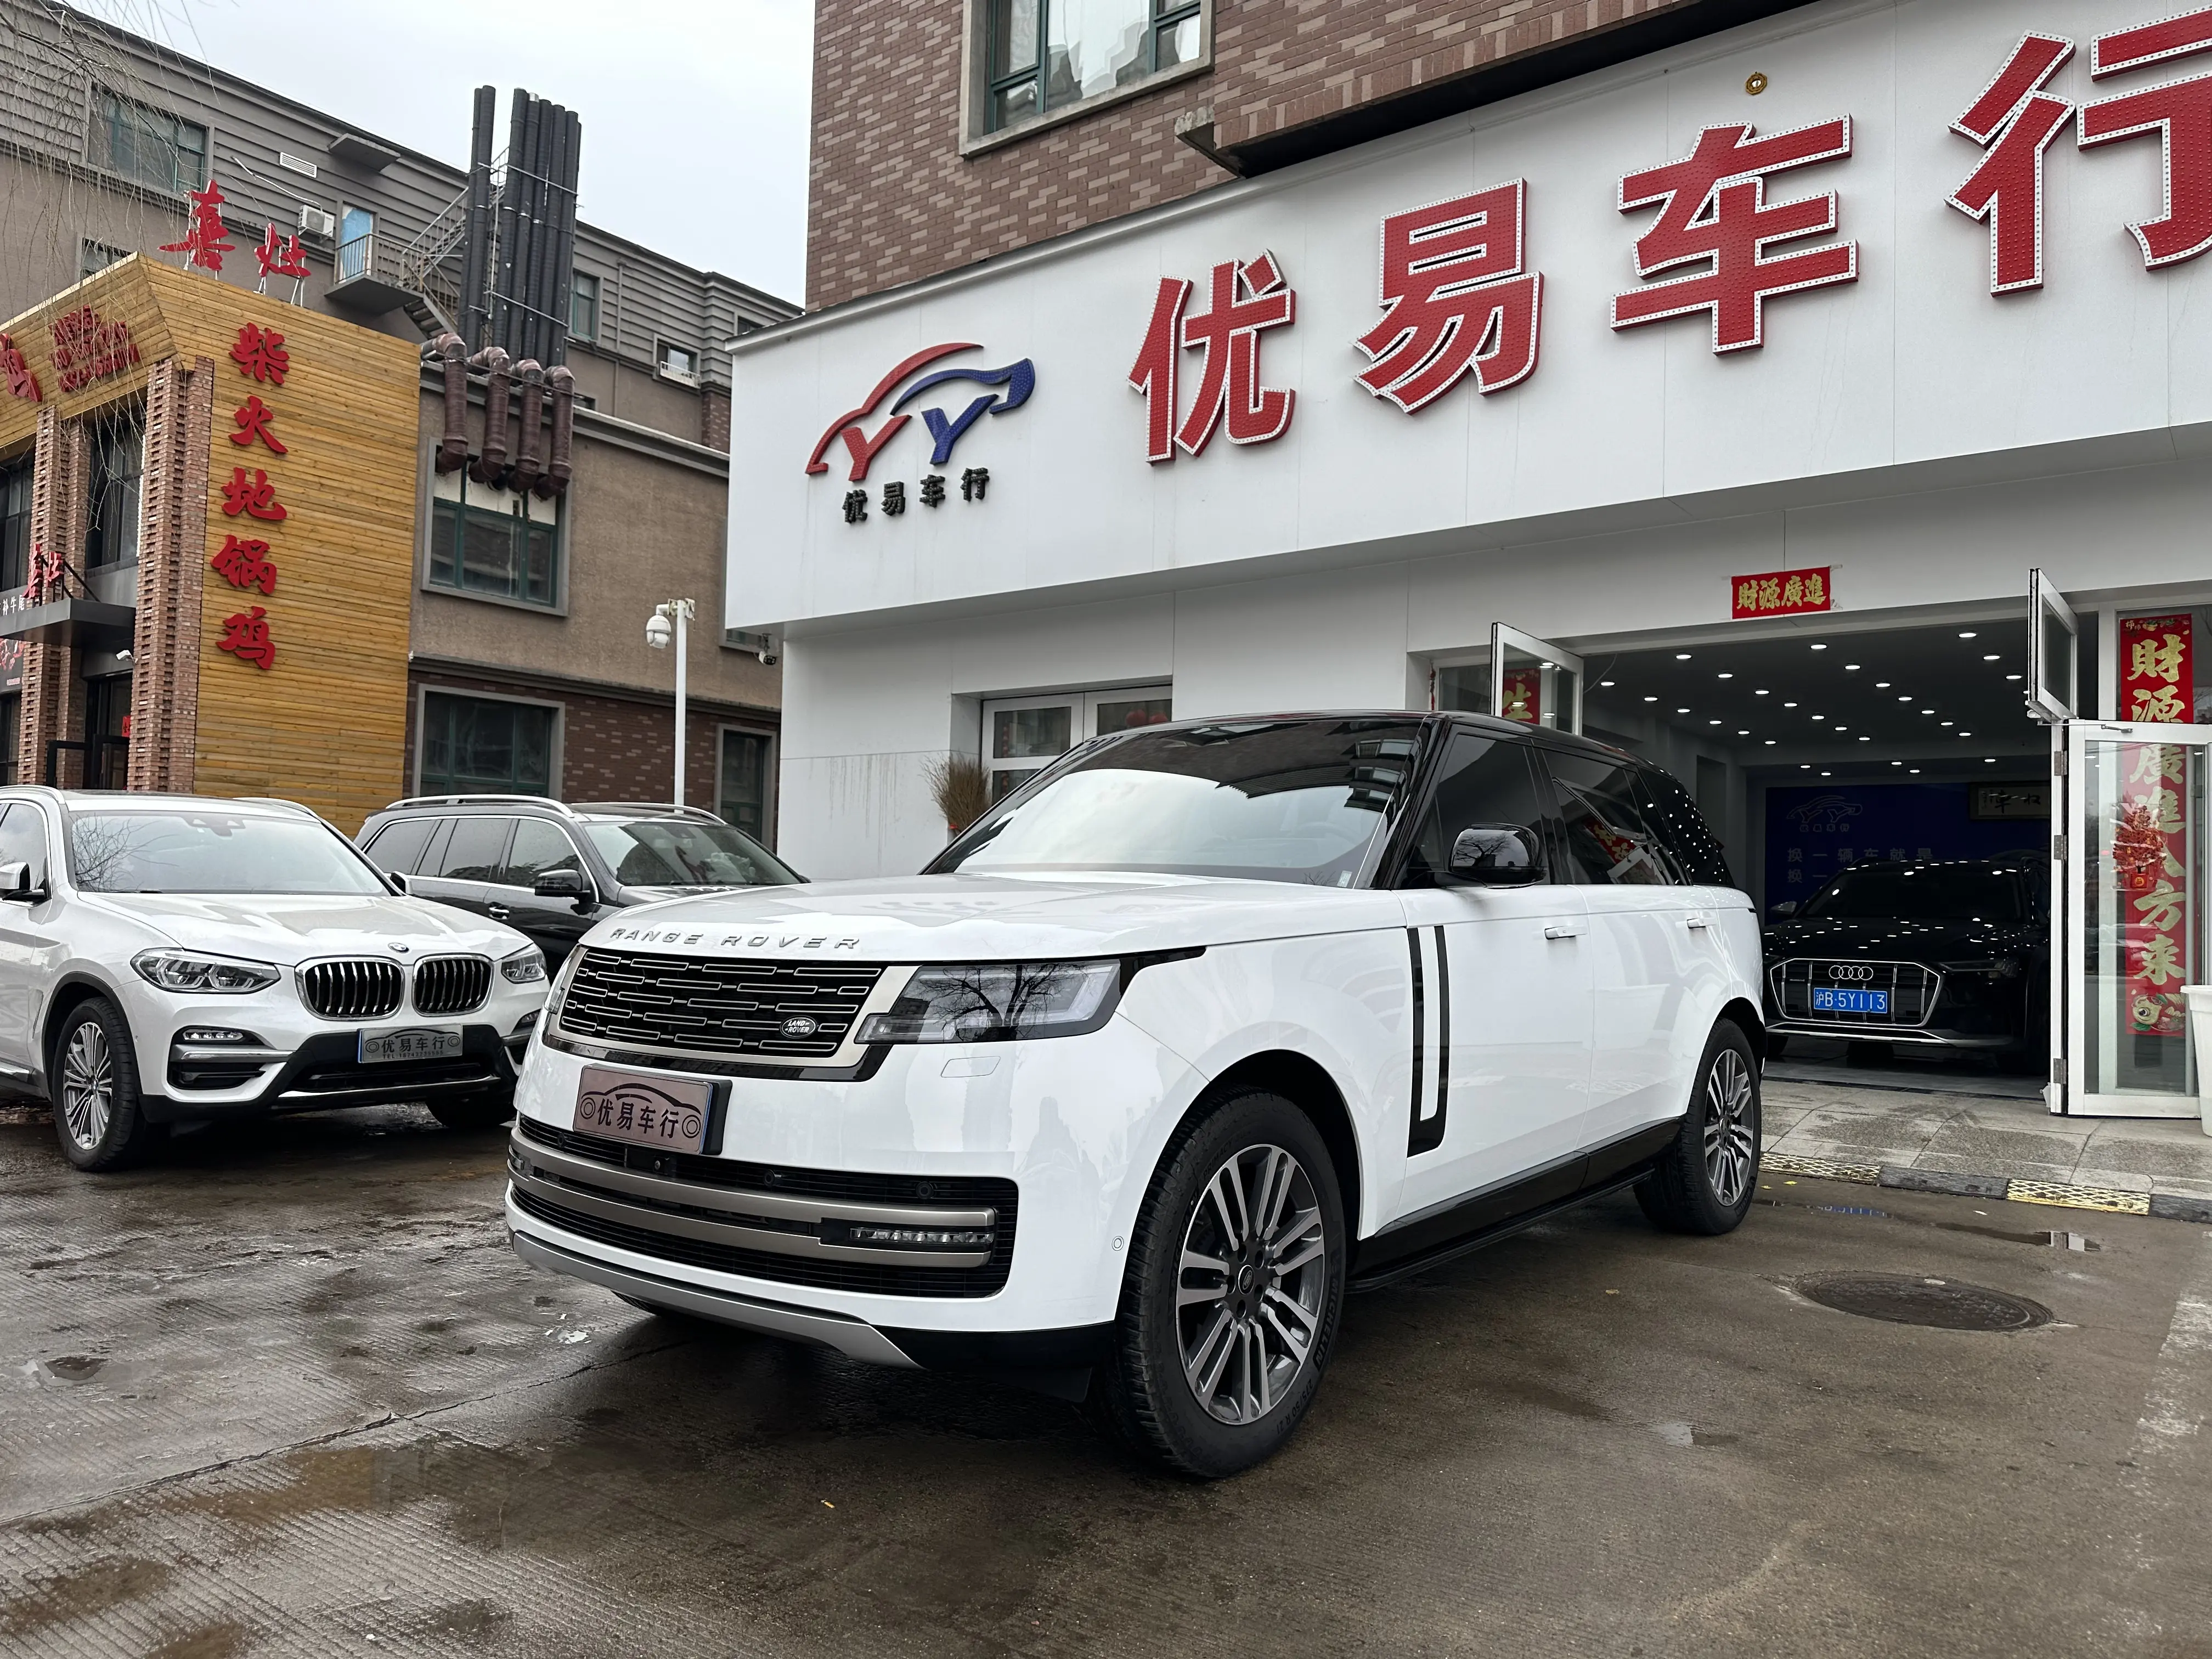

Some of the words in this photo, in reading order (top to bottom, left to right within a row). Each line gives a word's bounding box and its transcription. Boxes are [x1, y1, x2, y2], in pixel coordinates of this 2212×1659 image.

[1127, 10, 2212, 464] 优易车行
[210, 322, 290, 670] 柴火地锅鸡
[842, 467, 989, 523] 优易车行
[1737, 573, 1827, 611] 財源廣進
[610, 928, 704, 945] RANGE
[720, 934, 860, 949] ROVER
[382, 1036, 445, 1053] 优易车行
[597, 1098, 680, 1139] 优易车行
[1315, 1278, 1339, 1366] MICHELIN
